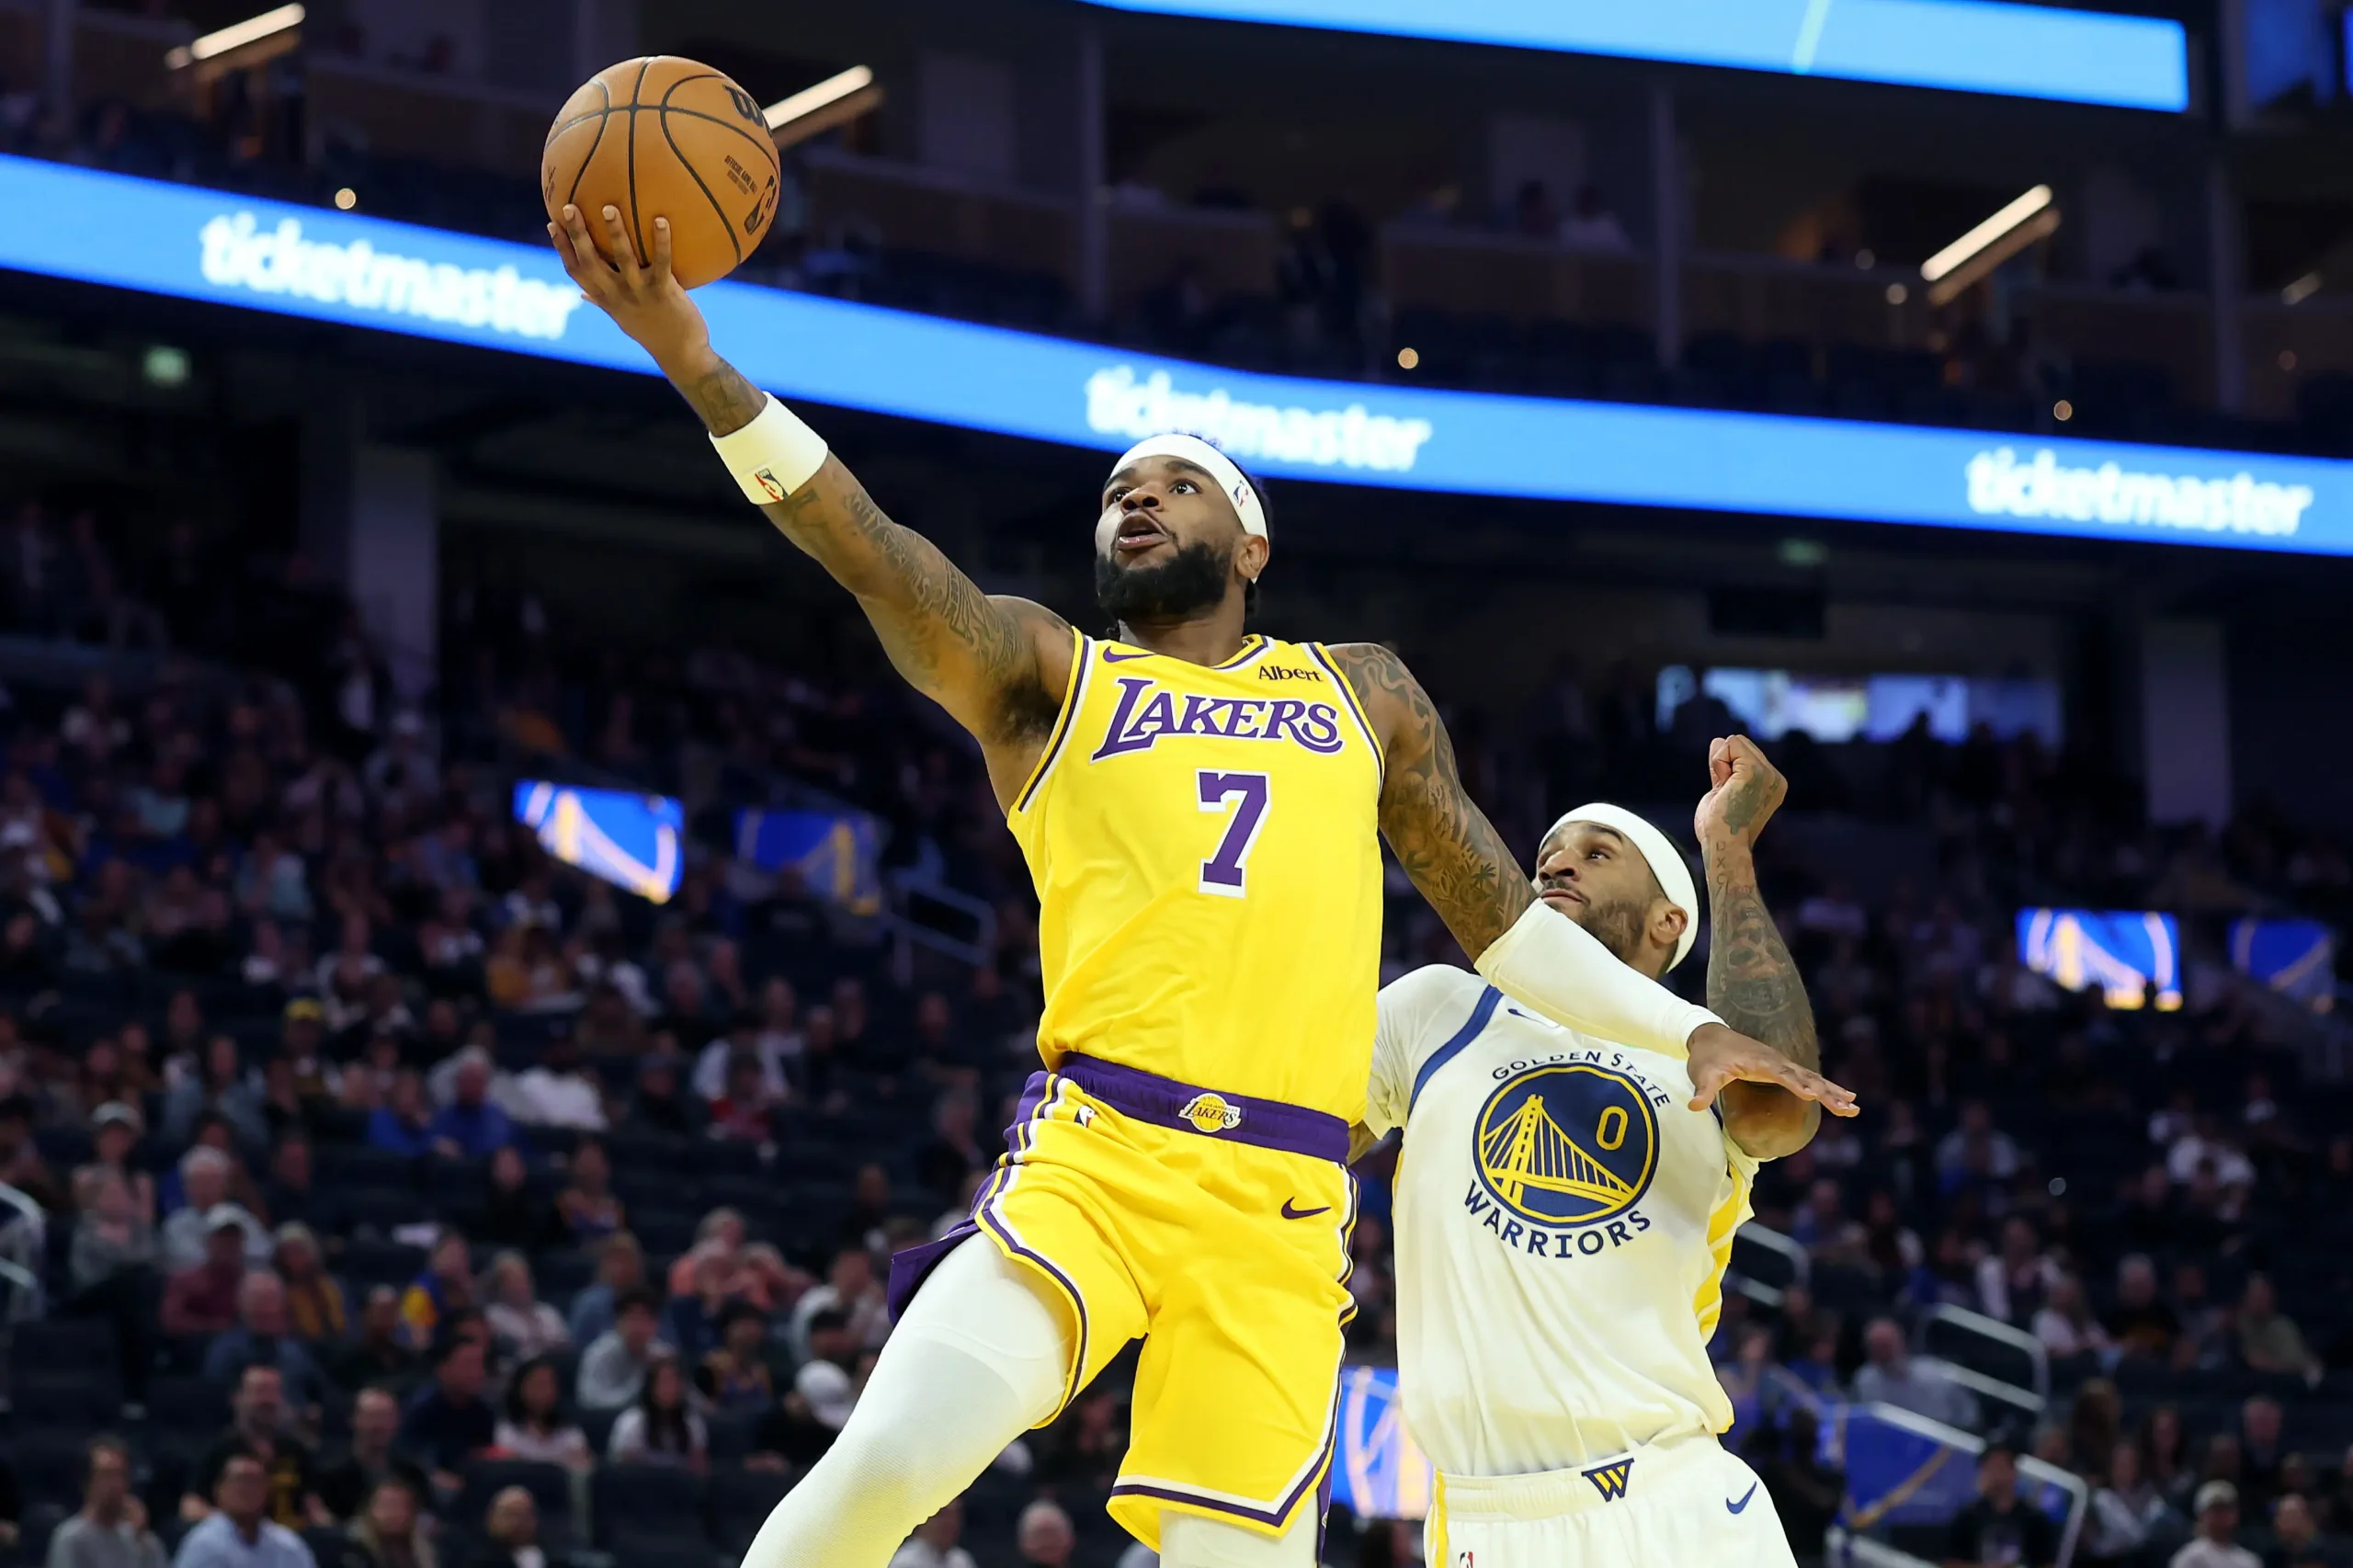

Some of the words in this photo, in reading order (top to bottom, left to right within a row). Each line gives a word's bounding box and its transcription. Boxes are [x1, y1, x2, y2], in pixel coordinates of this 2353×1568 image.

[200, 211, 581, 340] ticketmaster
[1085, 365, 1432, 472] ticketmaster
[1964, 446, 2313, 536] ticketmaster
[1258, 665, 1324, 683] Albert
[1090, 676, 1345, 764] LAKERS
[1196, 769, 1269, 897] 7
[1181, 1101, 1241, 1128] LAKERS
[1492, 1051, 1602, 1080] GOLDEN
[1610, 1052, 1671, 1108] STATE
[1596, 1106, 1630, 1151] 0
[1464, 1179, 1651, 1258] WARRIORS
